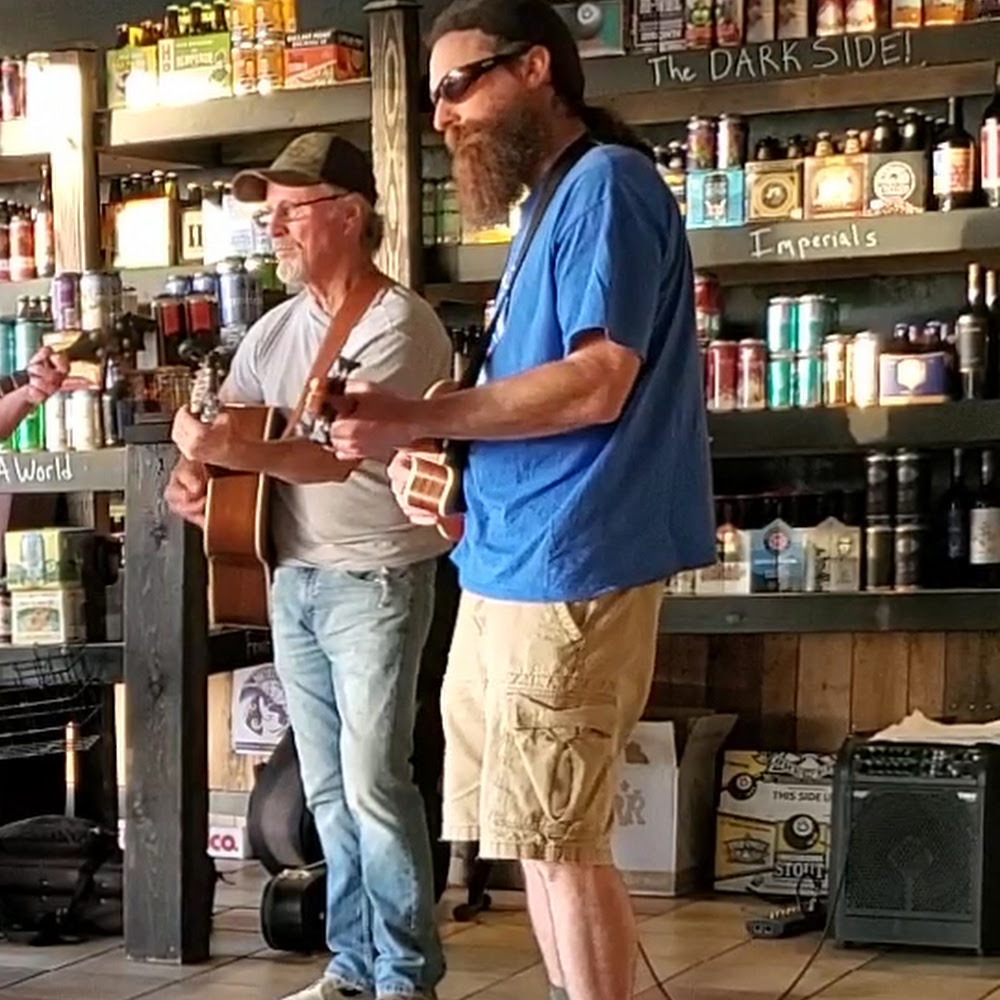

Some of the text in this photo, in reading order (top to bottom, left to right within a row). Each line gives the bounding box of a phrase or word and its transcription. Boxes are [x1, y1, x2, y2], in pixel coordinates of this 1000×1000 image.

[648, 31, 912, 86] The DARK SIDE!
[750, 224, 877, 259] Imperials
[13, 454, 73, 484] World
[772, 790, 796, 801] THIS
[798, 791, 820, 802] SIDE
[209, 833, 239, 852] CO.
[775, 861, 826, 879] STOUT
